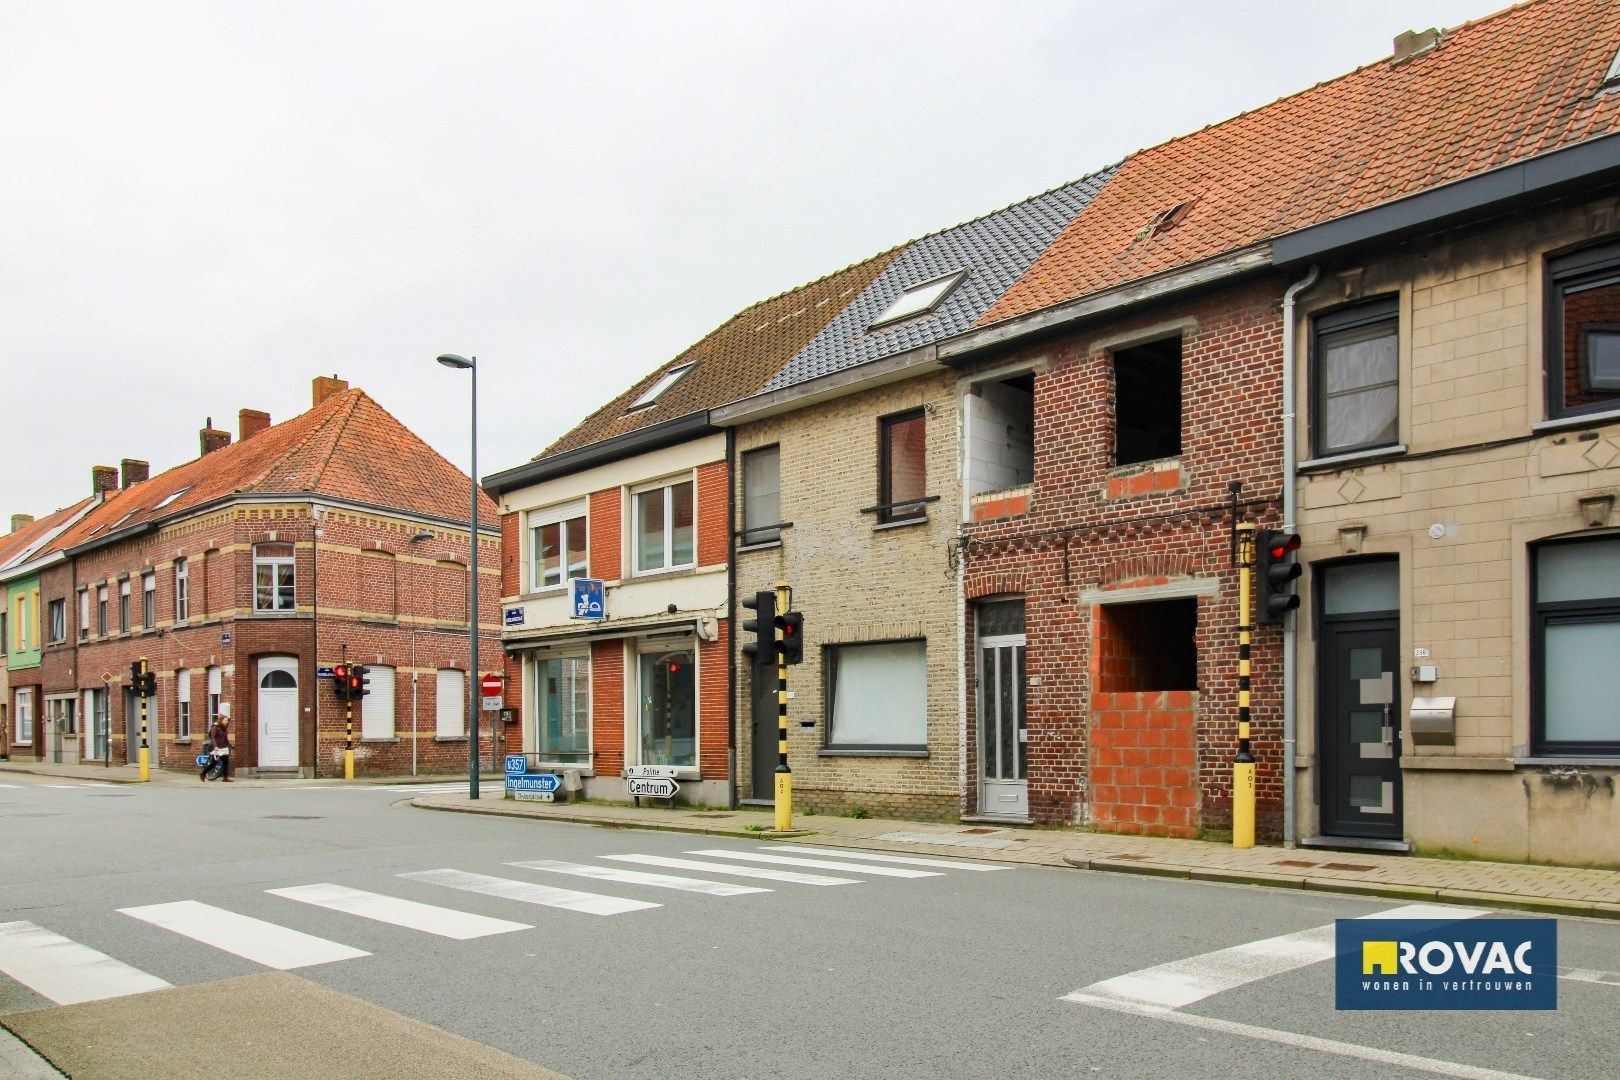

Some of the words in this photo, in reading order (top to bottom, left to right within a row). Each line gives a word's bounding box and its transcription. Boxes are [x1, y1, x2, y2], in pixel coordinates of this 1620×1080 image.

[507, 759, 523, 771] N357
[507, 776, 553, 790] Ingelmunster
[629, 779, 668, 795] Centrum
